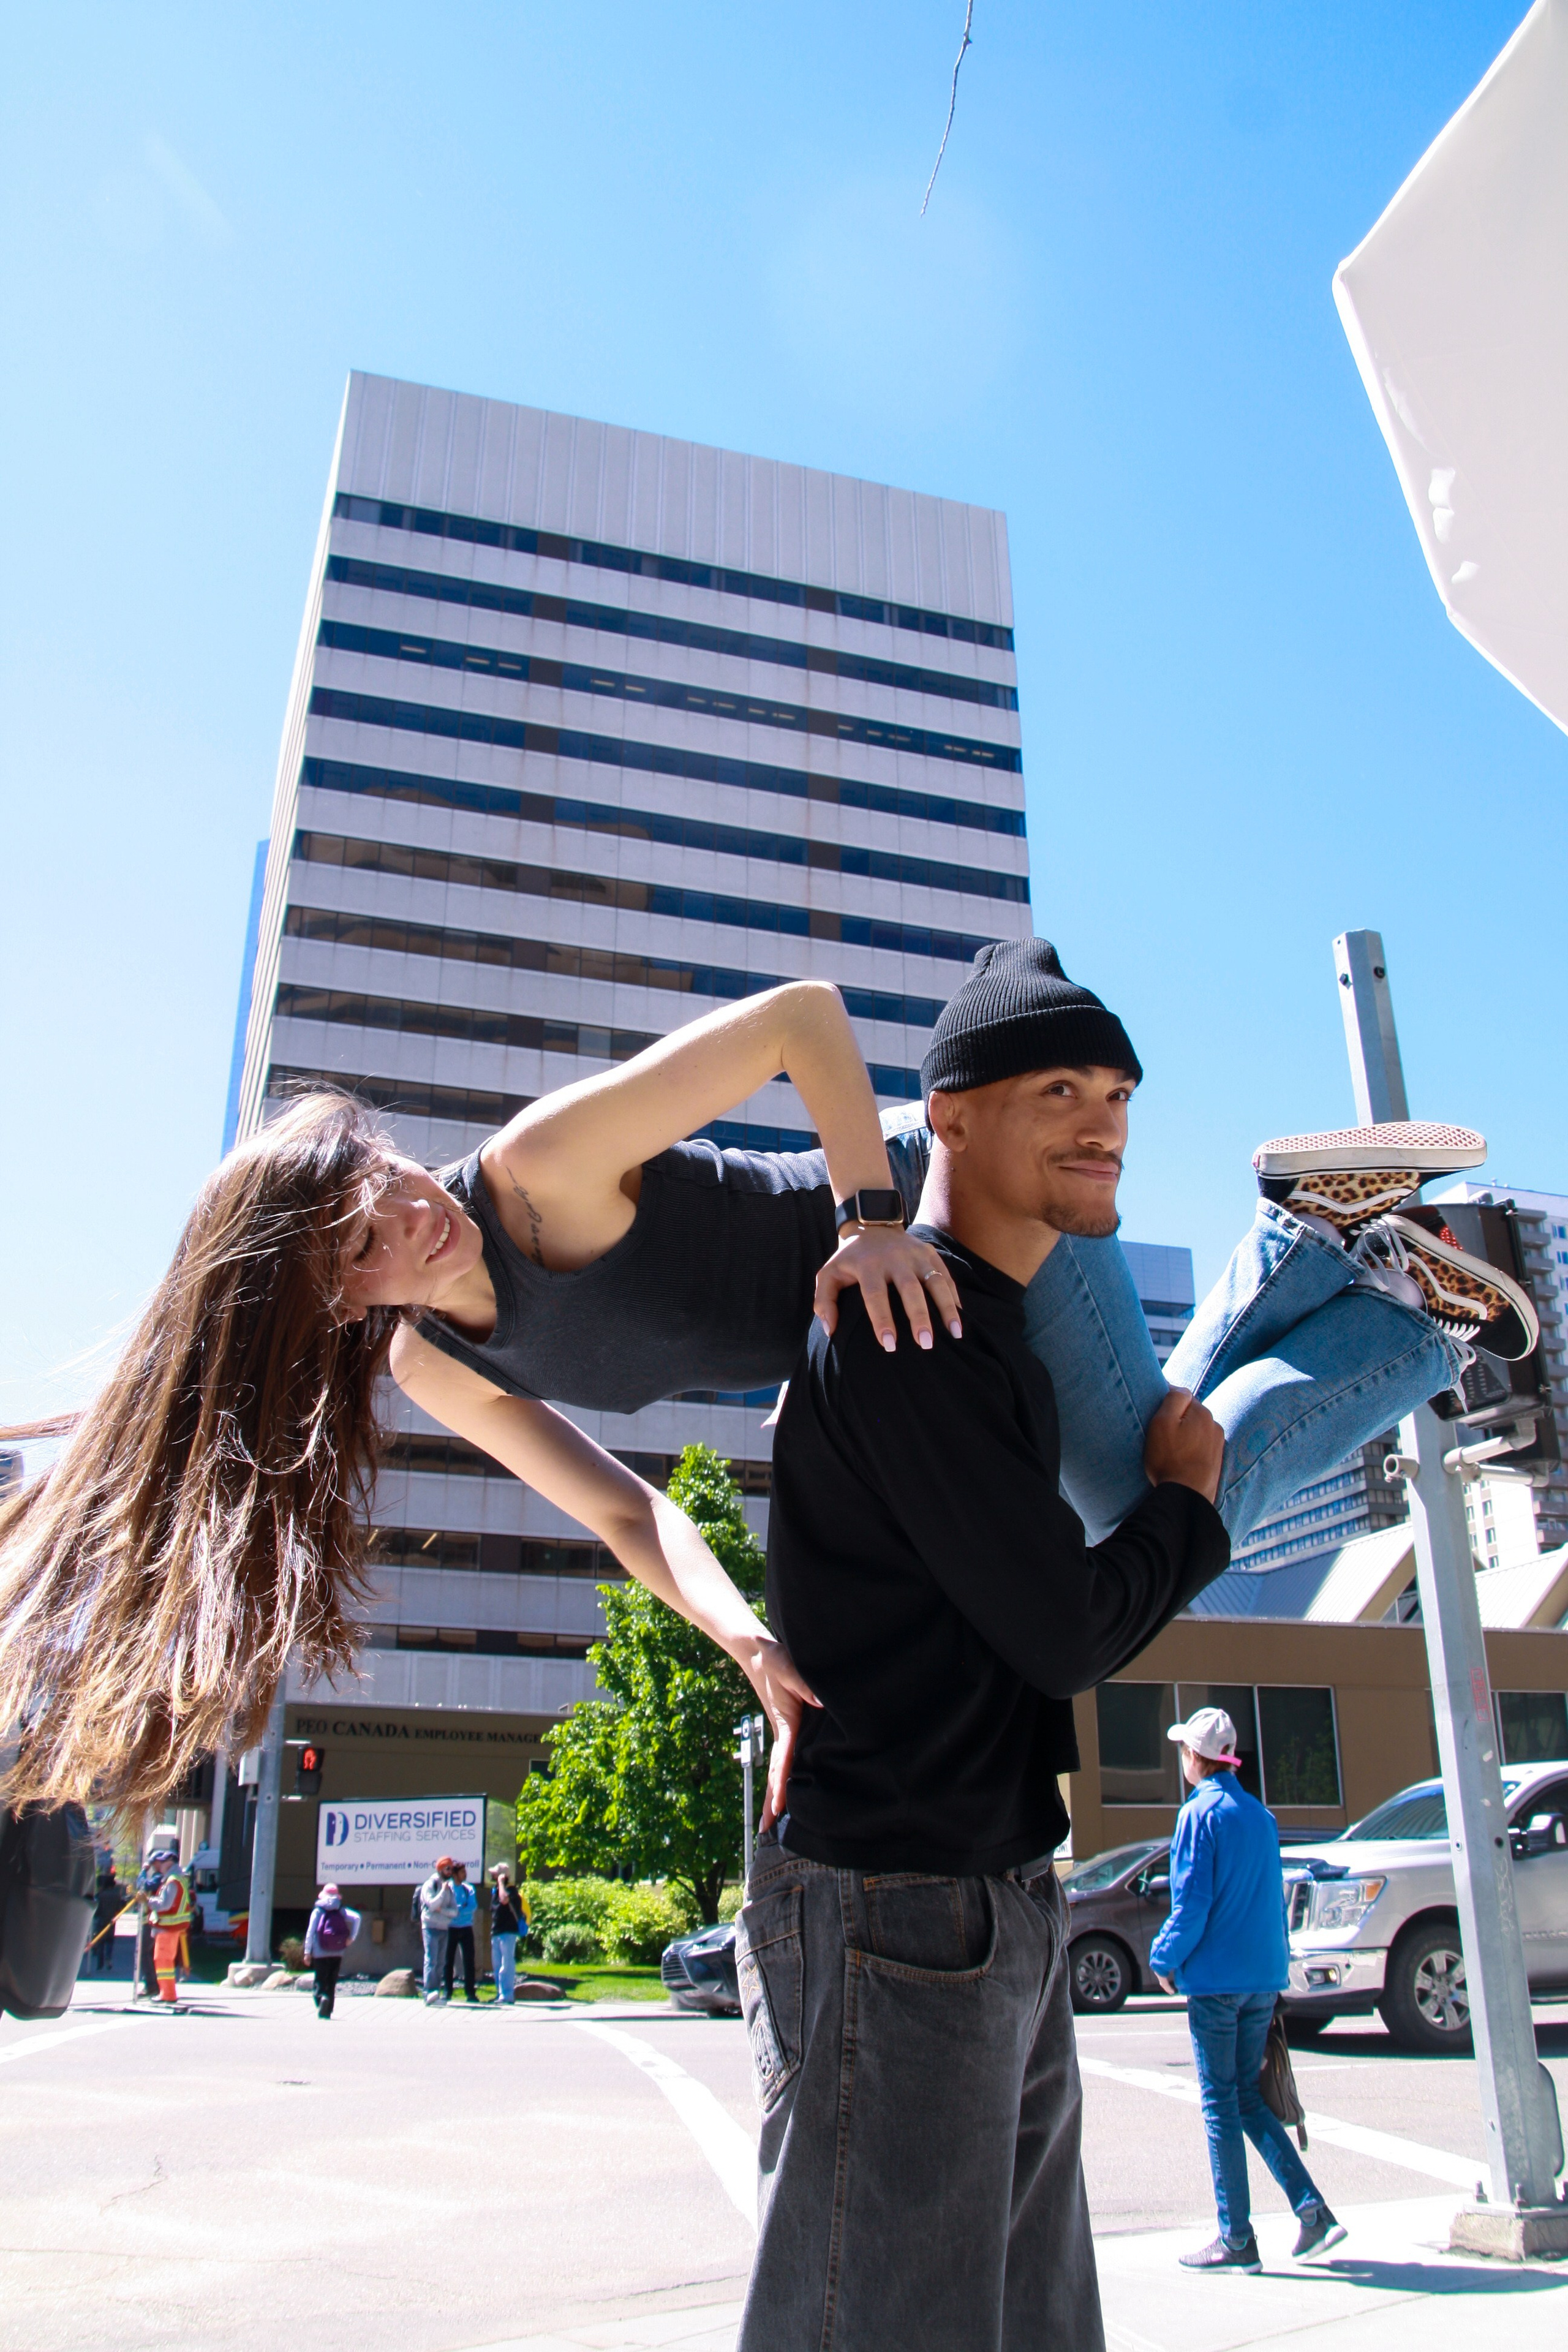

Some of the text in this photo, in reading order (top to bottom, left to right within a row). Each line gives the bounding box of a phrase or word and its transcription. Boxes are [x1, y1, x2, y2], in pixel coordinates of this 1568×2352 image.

[296, 1719, 328, 1734] PEO
[333, 1721, 409, 1738] CANADA
[415, 1728, 483, 1742] EMPLOYEE
[355, 1811, 477, 1830] DIVERSIFIED
[353, 1829, 476, 1843] STAFFING SERVICES
[321, 1862, 359, 1872] Temporary
[366, 1861, 406, 1870] Permanent
[453, 1860, 480, 1869] Proll
